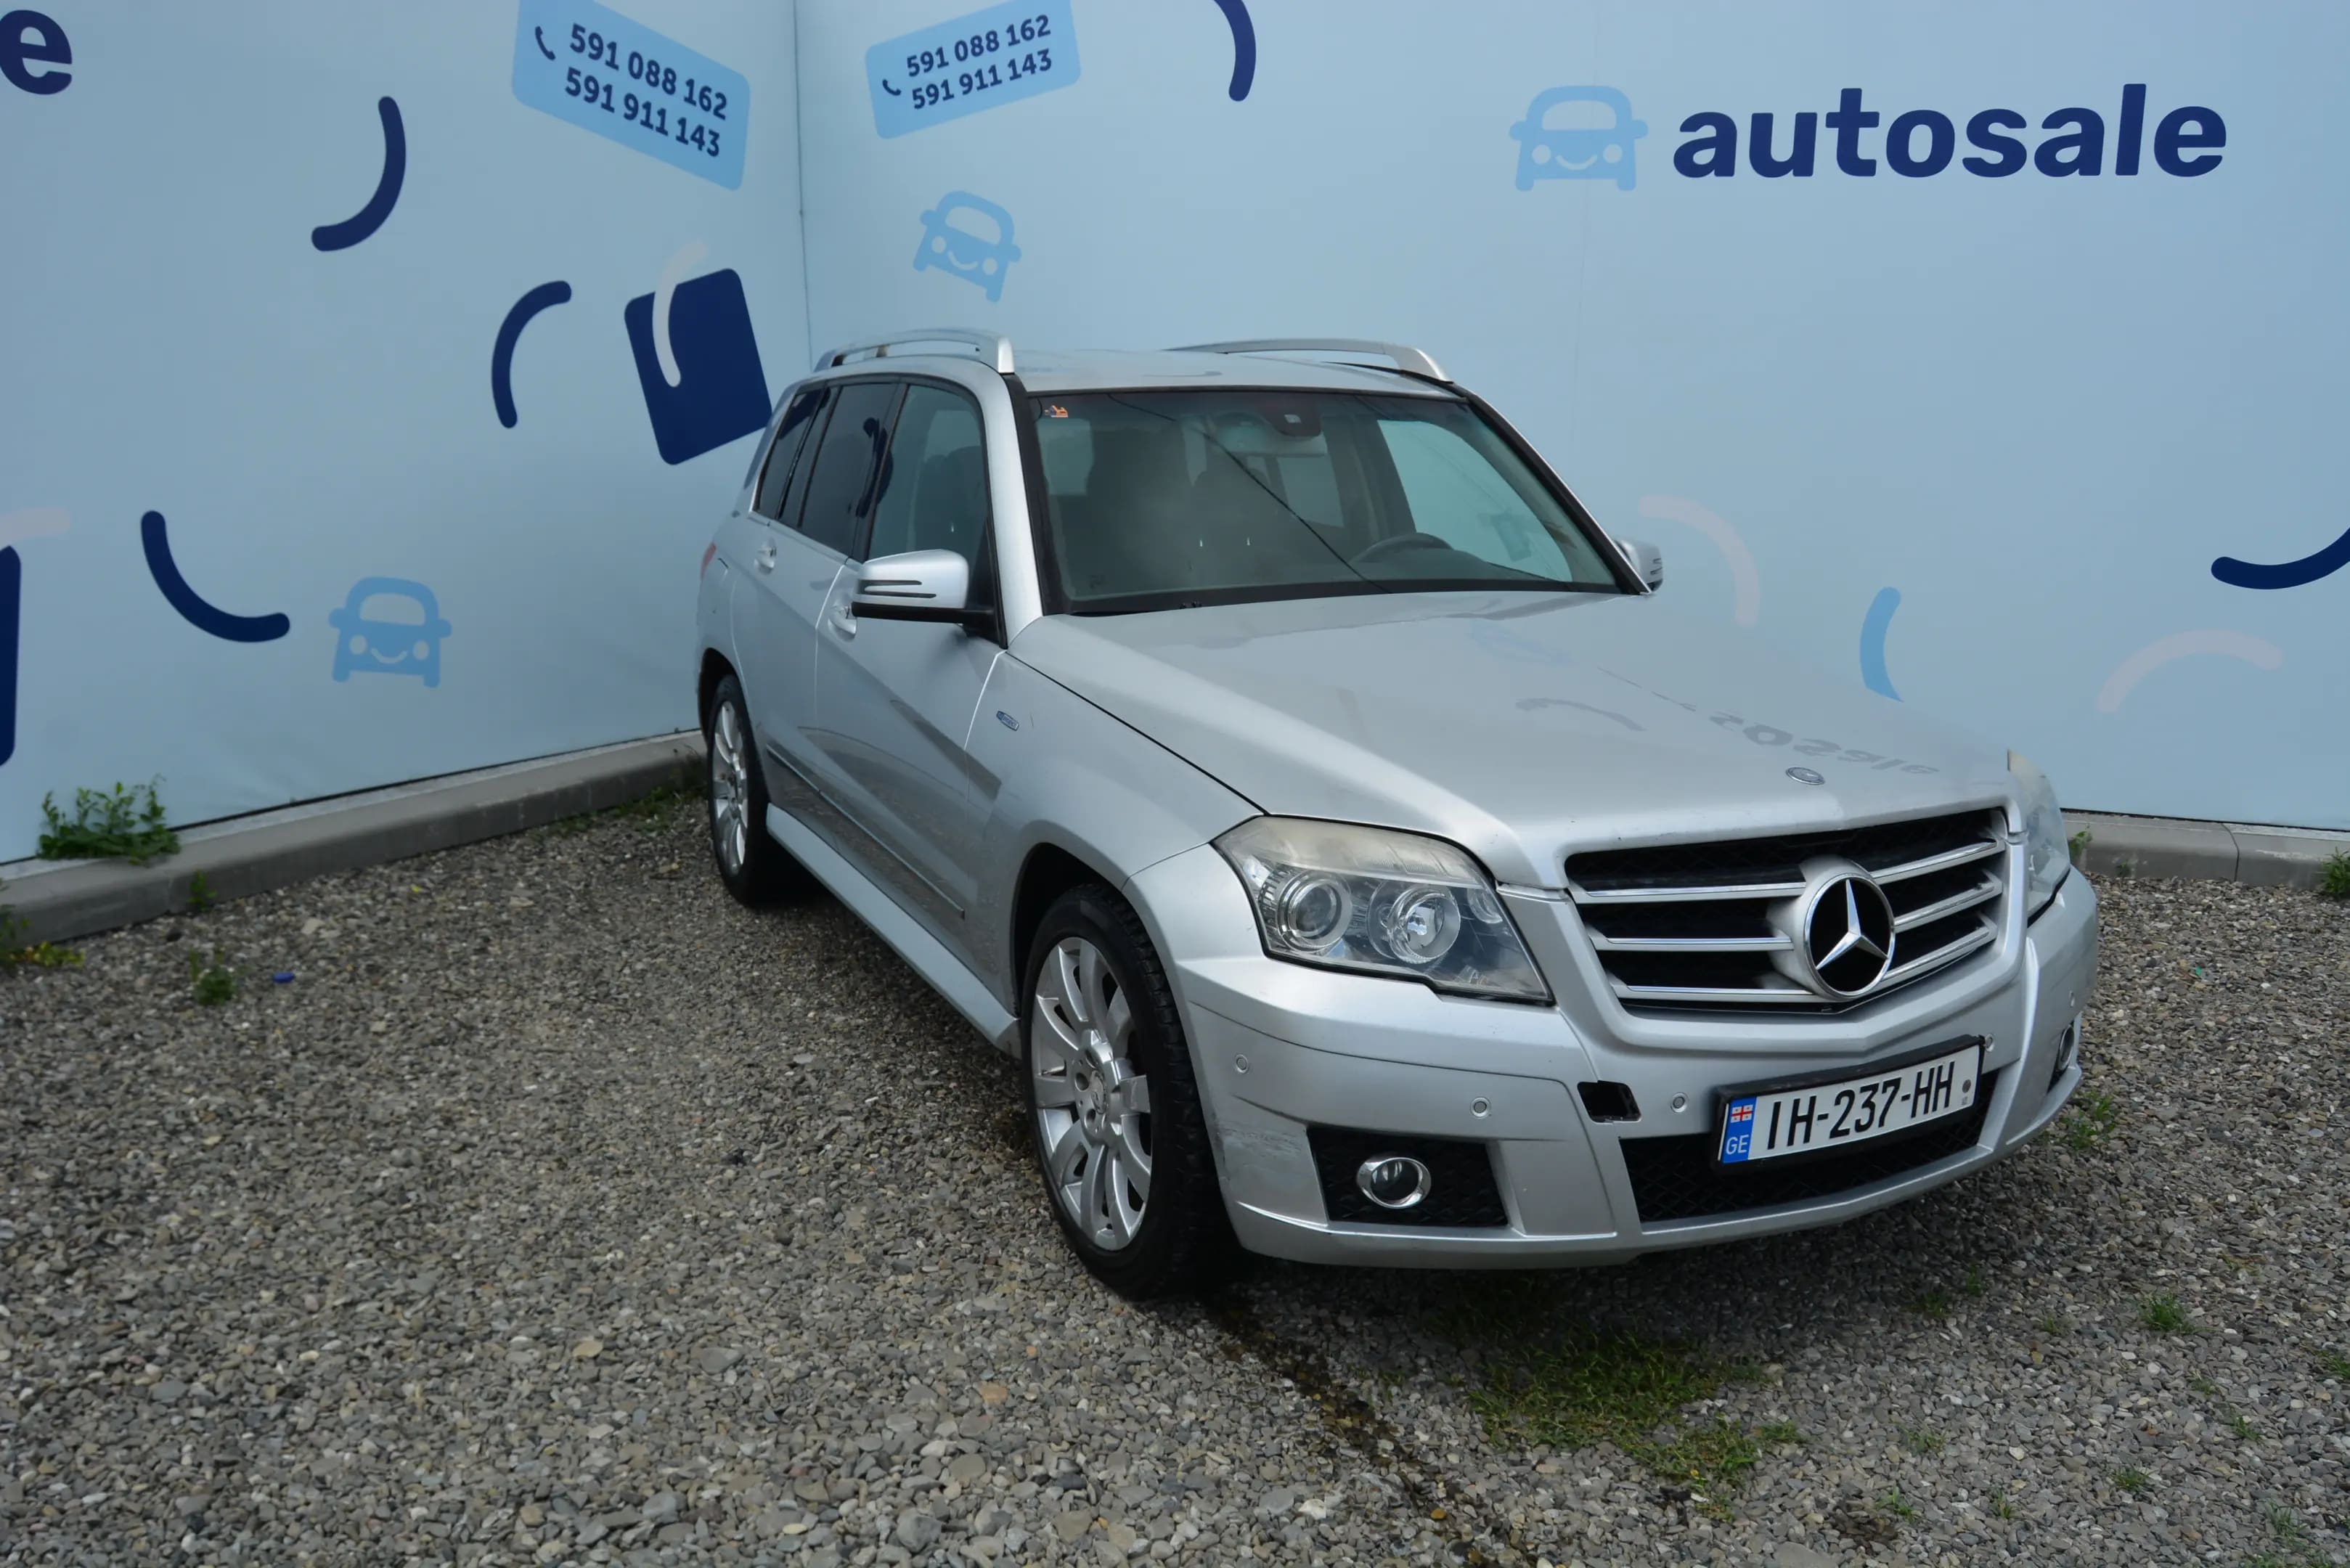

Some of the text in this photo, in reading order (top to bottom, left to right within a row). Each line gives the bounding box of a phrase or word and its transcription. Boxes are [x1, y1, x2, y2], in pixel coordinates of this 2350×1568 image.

[568, 22, 728, 122] 591 088 162
[906, 14, 1052, 78] 591 088 162
[911, 47, 1053, 110] 591 911 143
[564, 65, 721, 158] 591 911 143
[1673, 83, 2227, 179] autosale
[1725, 1134, 1750, 1155] GE
[1766, 1061, 1956, 1151] IH-237-HH
